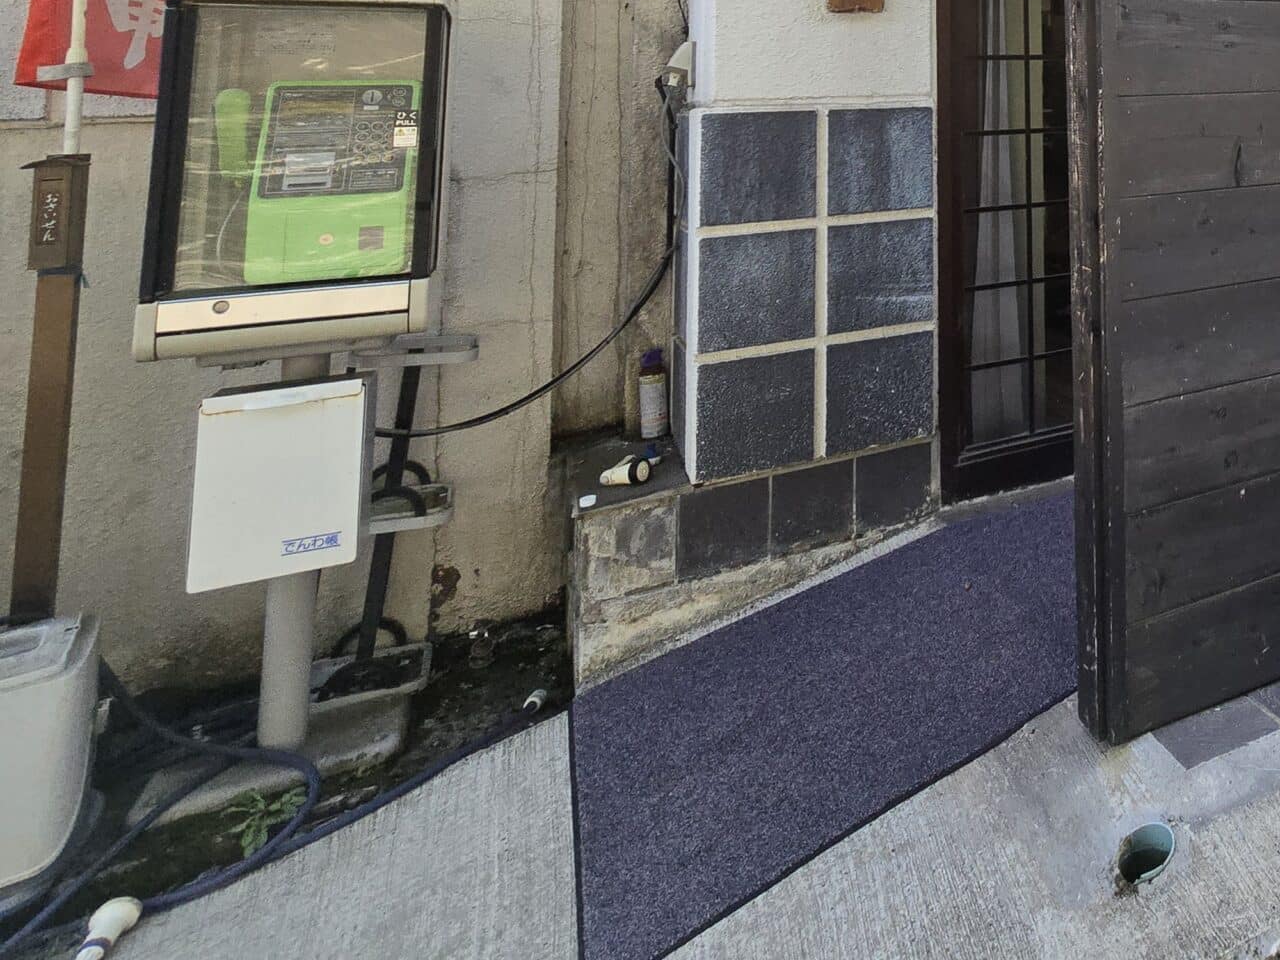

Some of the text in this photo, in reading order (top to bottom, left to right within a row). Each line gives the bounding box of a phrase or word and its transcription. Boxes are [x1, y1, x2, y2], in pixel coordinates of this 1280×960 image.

[41, 193, 60, 242] おさいせん
